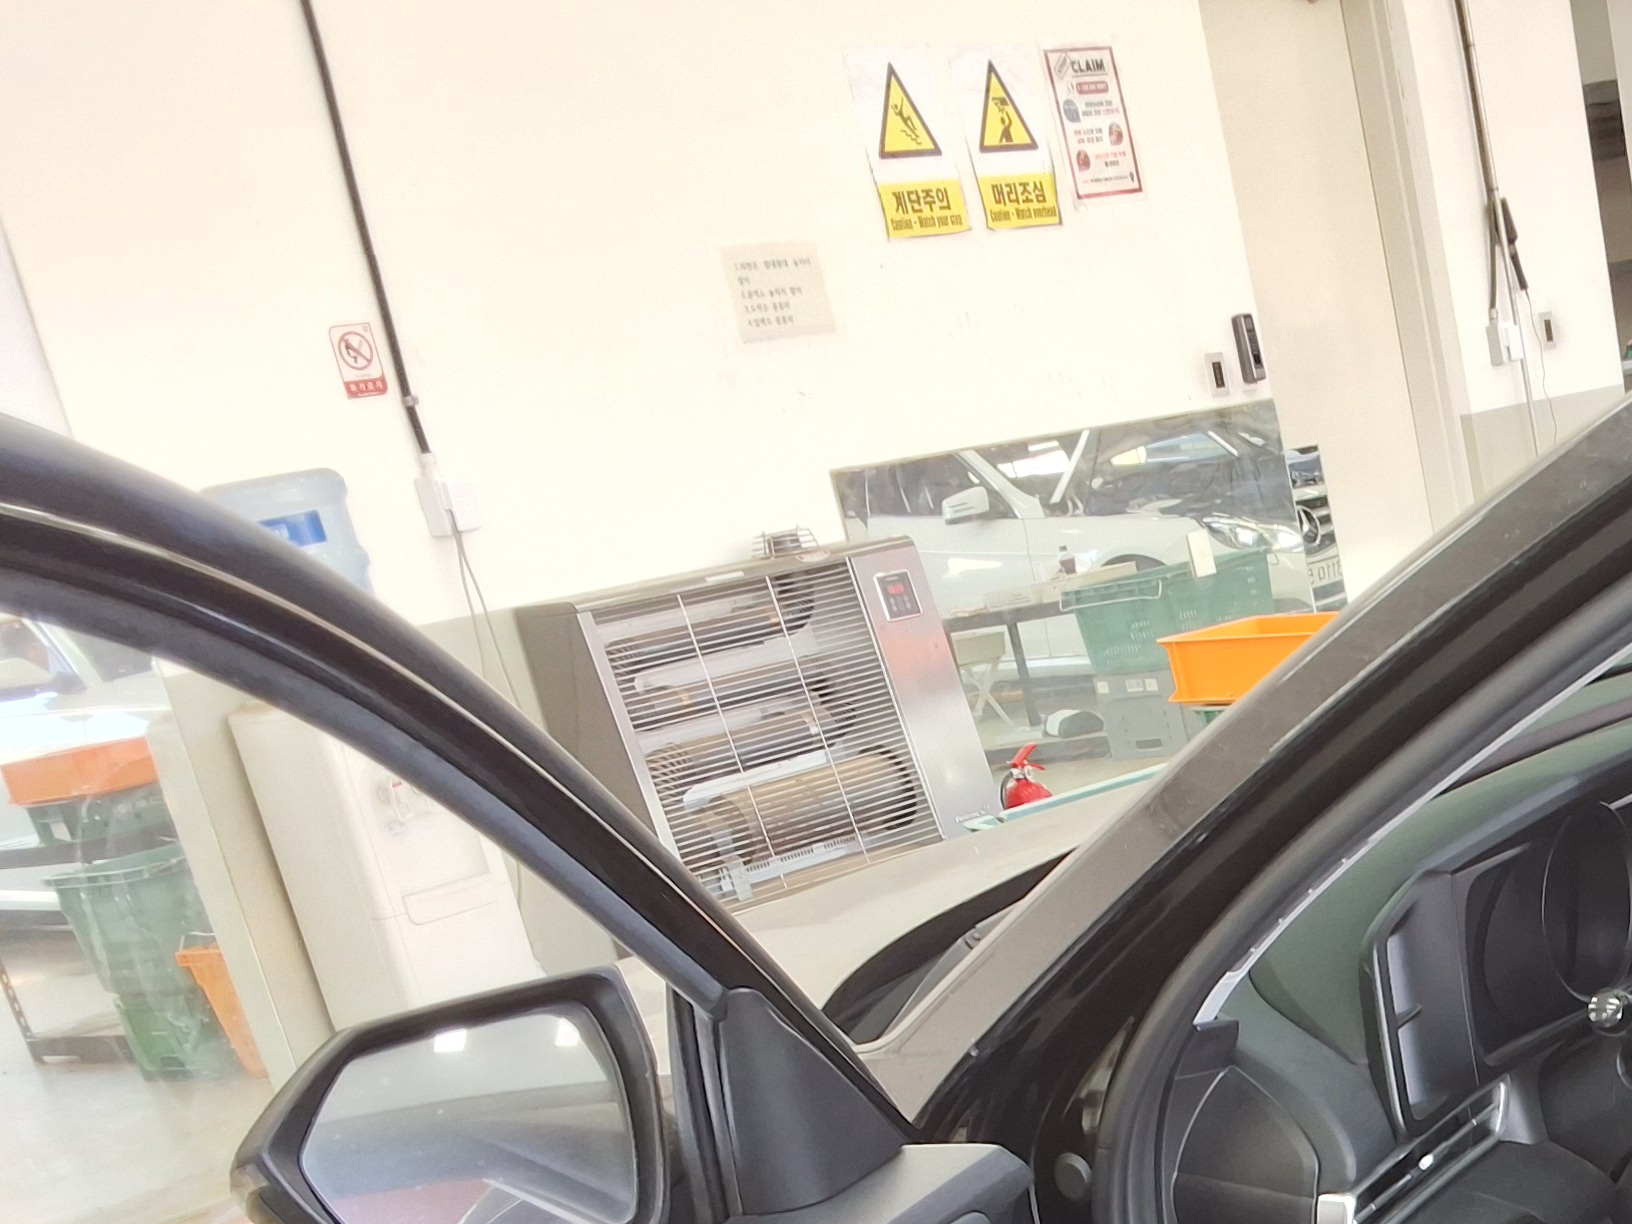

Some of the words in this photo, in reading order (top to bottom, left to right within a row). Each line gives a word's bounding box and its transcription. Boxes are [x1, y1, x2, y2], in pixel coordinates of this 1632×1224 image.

[1071, 58, 1106, 73] CLAIM
[891, 187, 952, 215] 계단주의
[991, 180, 1047, 206] 머리조심
